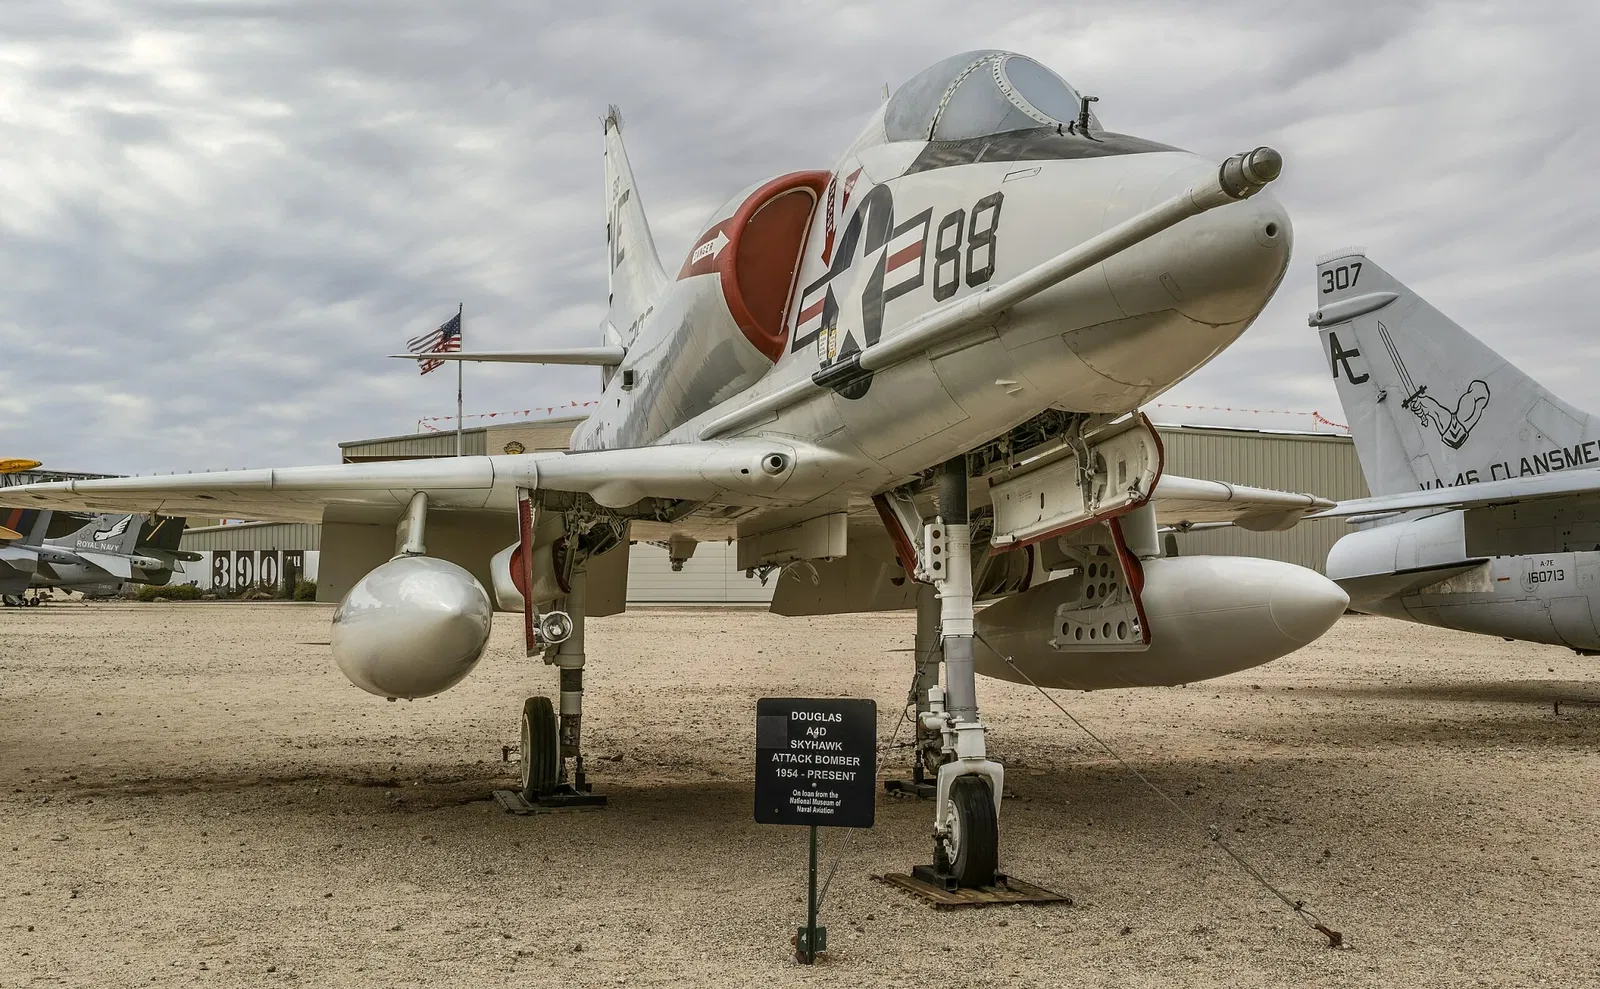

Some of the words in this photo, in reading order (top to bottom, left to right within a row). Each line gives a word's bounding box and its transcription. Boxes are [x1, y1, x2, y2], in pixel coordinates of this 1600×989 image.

[933, 191, 1004, 302] 88
[1321, 262, 1363, 294] 307
[1491, 440, 1600, 482] CLANSME
[77, 540, 99, 549] ROYAL
[101, 542, 120, 551] NAVY
[214, 556, 277, 587] 390
[1528, 569, 1565, 584] 160713
[791, 711, 842, 722] DOUGLAS
[806, 726, 827, 736] A4D
[790, 739, 843, 751] SKYHAWK
[771, 753, 812, 763] ATTACK
[815, 755, 860, 766] BOMBER
[775, 768, 799, 778] 1954
[807, 769, 857, 781] PRESENT
[792, 789, 801, 797] On
[802, 789, 814, 797] loan
[815, 790, 828, 798] from
[829, 789, 839, 799] the
[789, 796, 812, 805] National
[812, 798, 835, 806] Museum
[835, 799, 842, 807] of
[797, 805, 812, 813] Naval
[812, 806, 835, 815] Aviation
